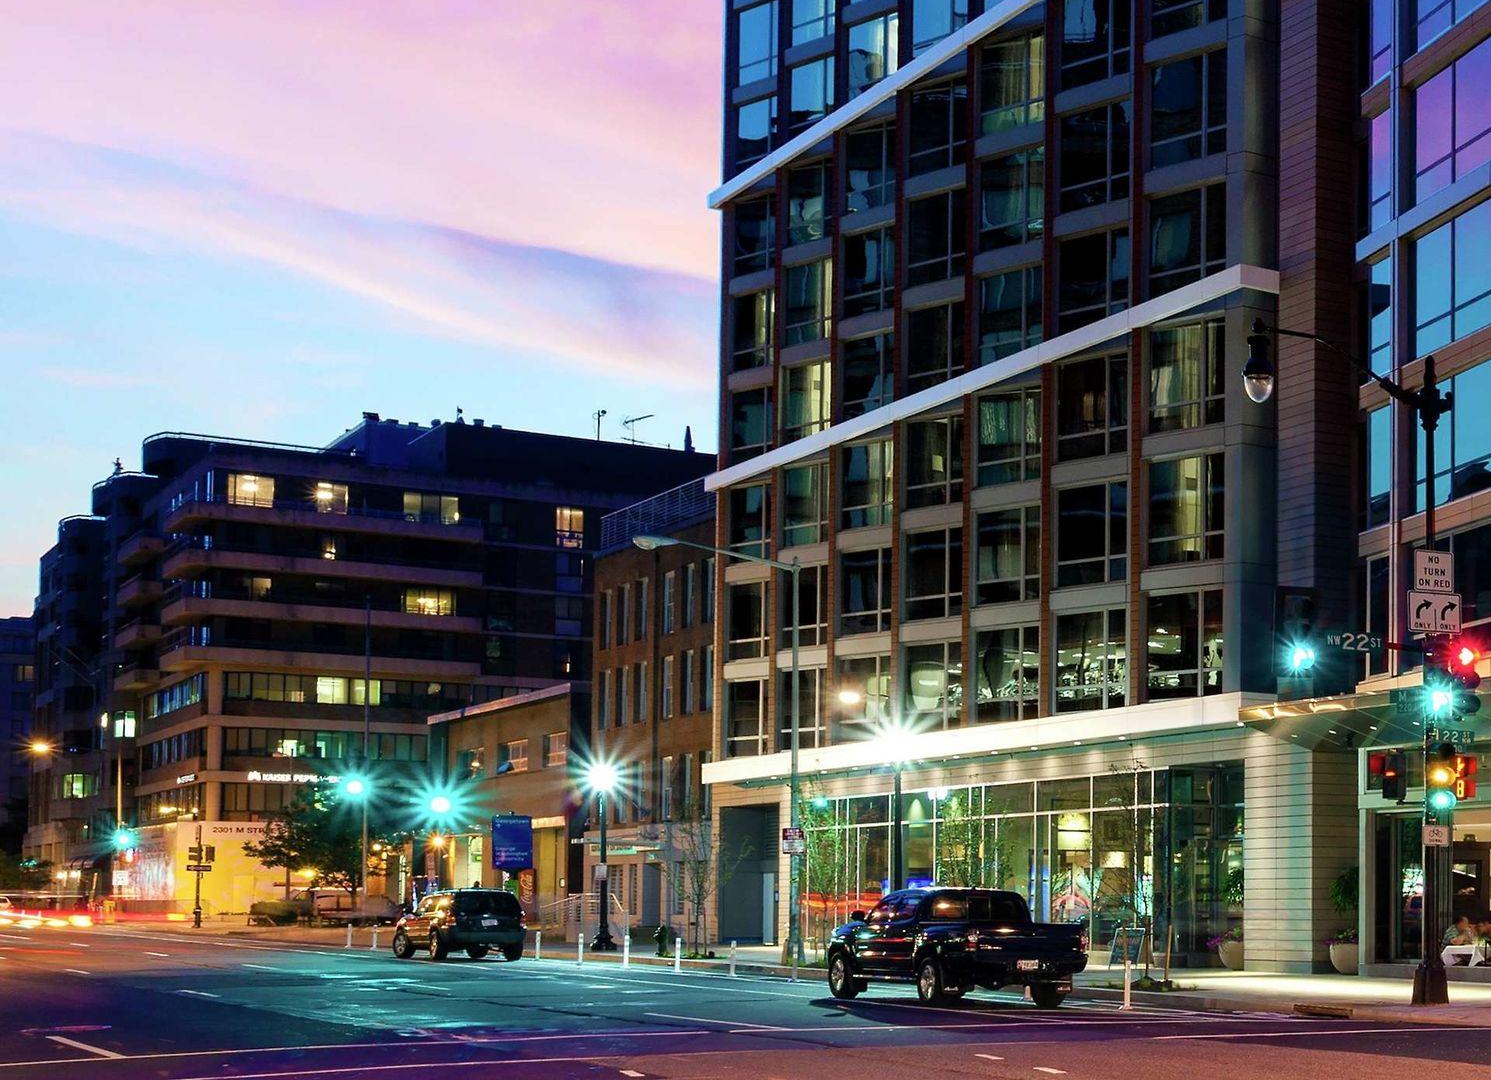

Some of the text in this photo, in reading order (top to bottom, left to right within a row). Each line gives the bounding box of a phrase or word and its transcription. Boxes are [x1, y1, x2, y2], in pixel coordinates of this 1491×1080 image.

[1427, 555, 1440, 565] NO
[1423, 567, 1446, 577] TURN
[1418, 578, 1451, 589] ON RED
[1327, 632, 1382, 651] NW 22 ST
[212, 826, 233, 834] 2301
